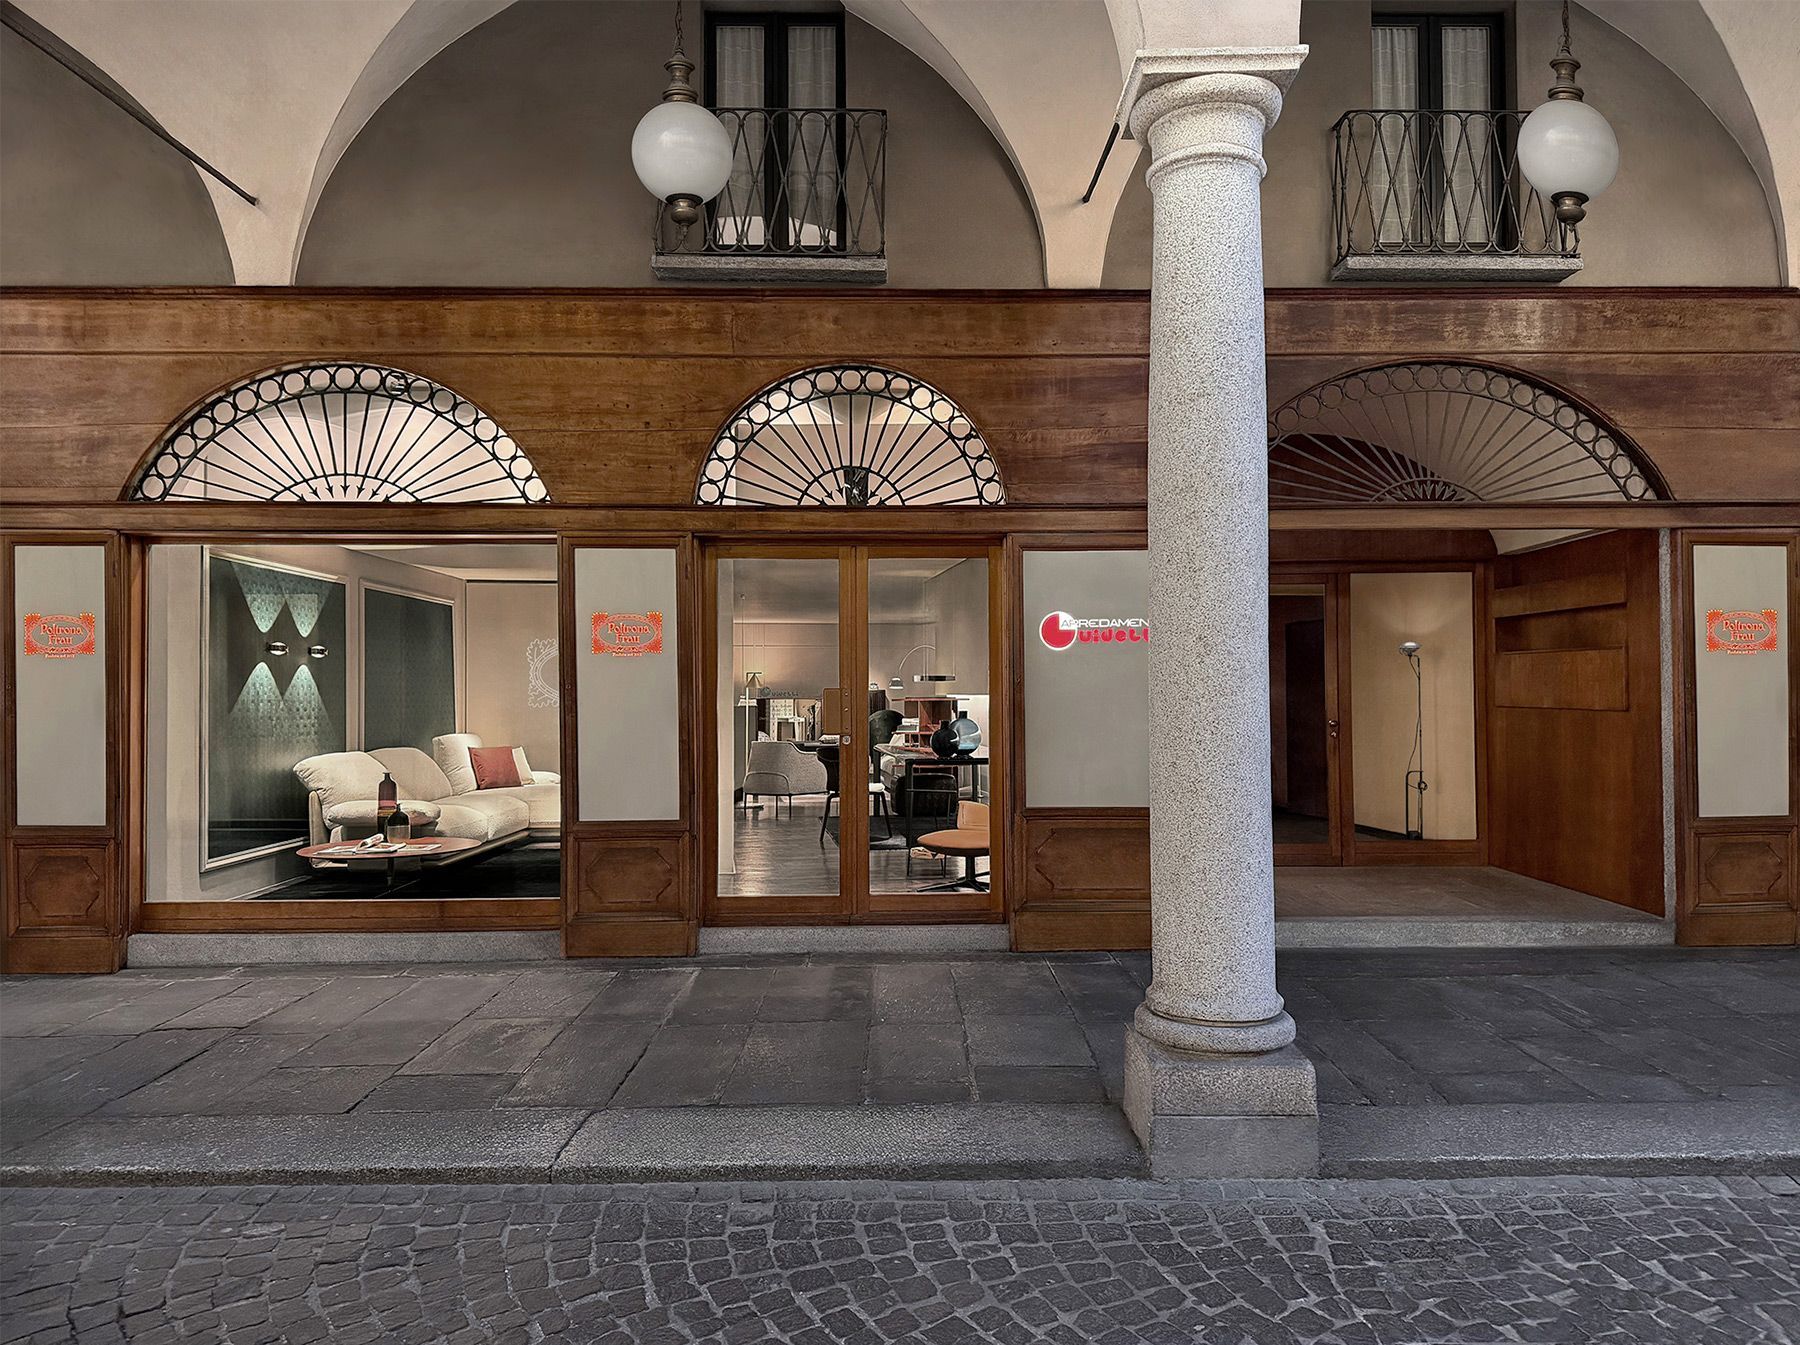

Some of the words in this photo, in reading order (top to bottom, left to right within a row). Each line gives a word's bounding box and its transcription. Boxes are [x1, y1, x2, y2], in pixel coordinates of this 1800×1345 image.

[40, 623, 84, 635] Poltrona
[607, 622, 651, 634] Poltrona
[1722, 620, 1766, 631] Poltrona
[48, 635, 73, 645] Frau
[615, 634, 640, 643] Frau
[1730, 631, 1755, 641] Frau
